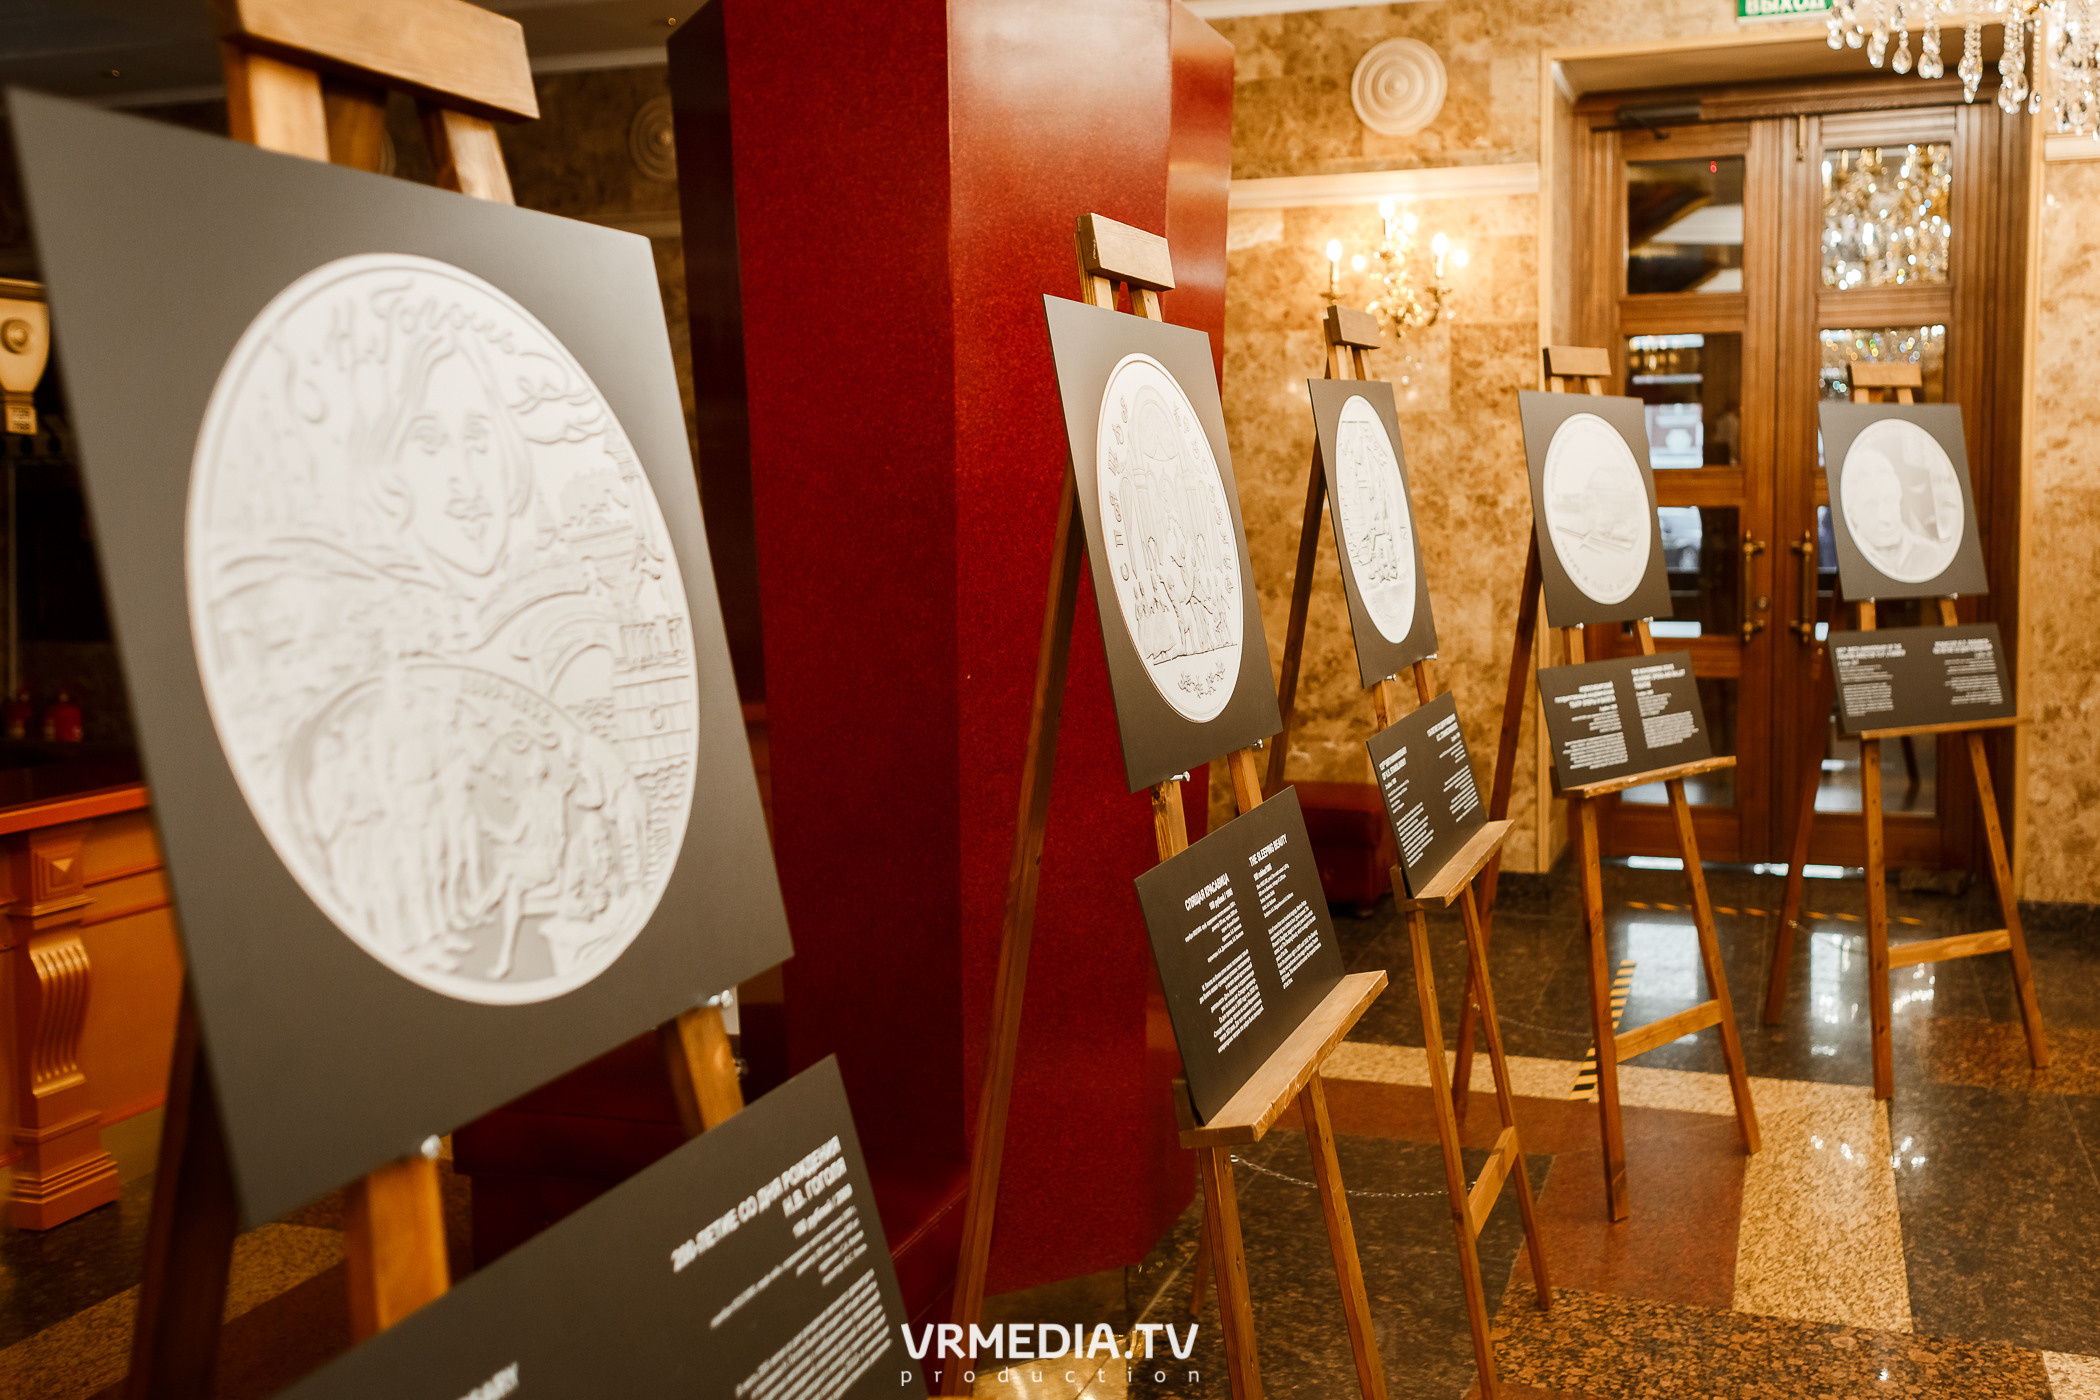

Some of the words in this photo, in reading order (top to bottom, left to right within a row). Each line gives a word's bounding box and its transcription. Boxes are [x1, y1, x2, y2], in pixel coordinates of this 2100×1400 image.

[1249, 853, 1258, 867] THE
[1257, 842, 1274, 862] SLEEPING
[1273, 833, 1287, 851] BEAUTY
[737, 1195, 758, 1224] СО
[756, 1177, 784, 1214] ДНЯ
[781, 1134, 842, 1191] РОЖДЕНИЯ
[804, 1156, 847, 1200] ГОГОЛЯ
